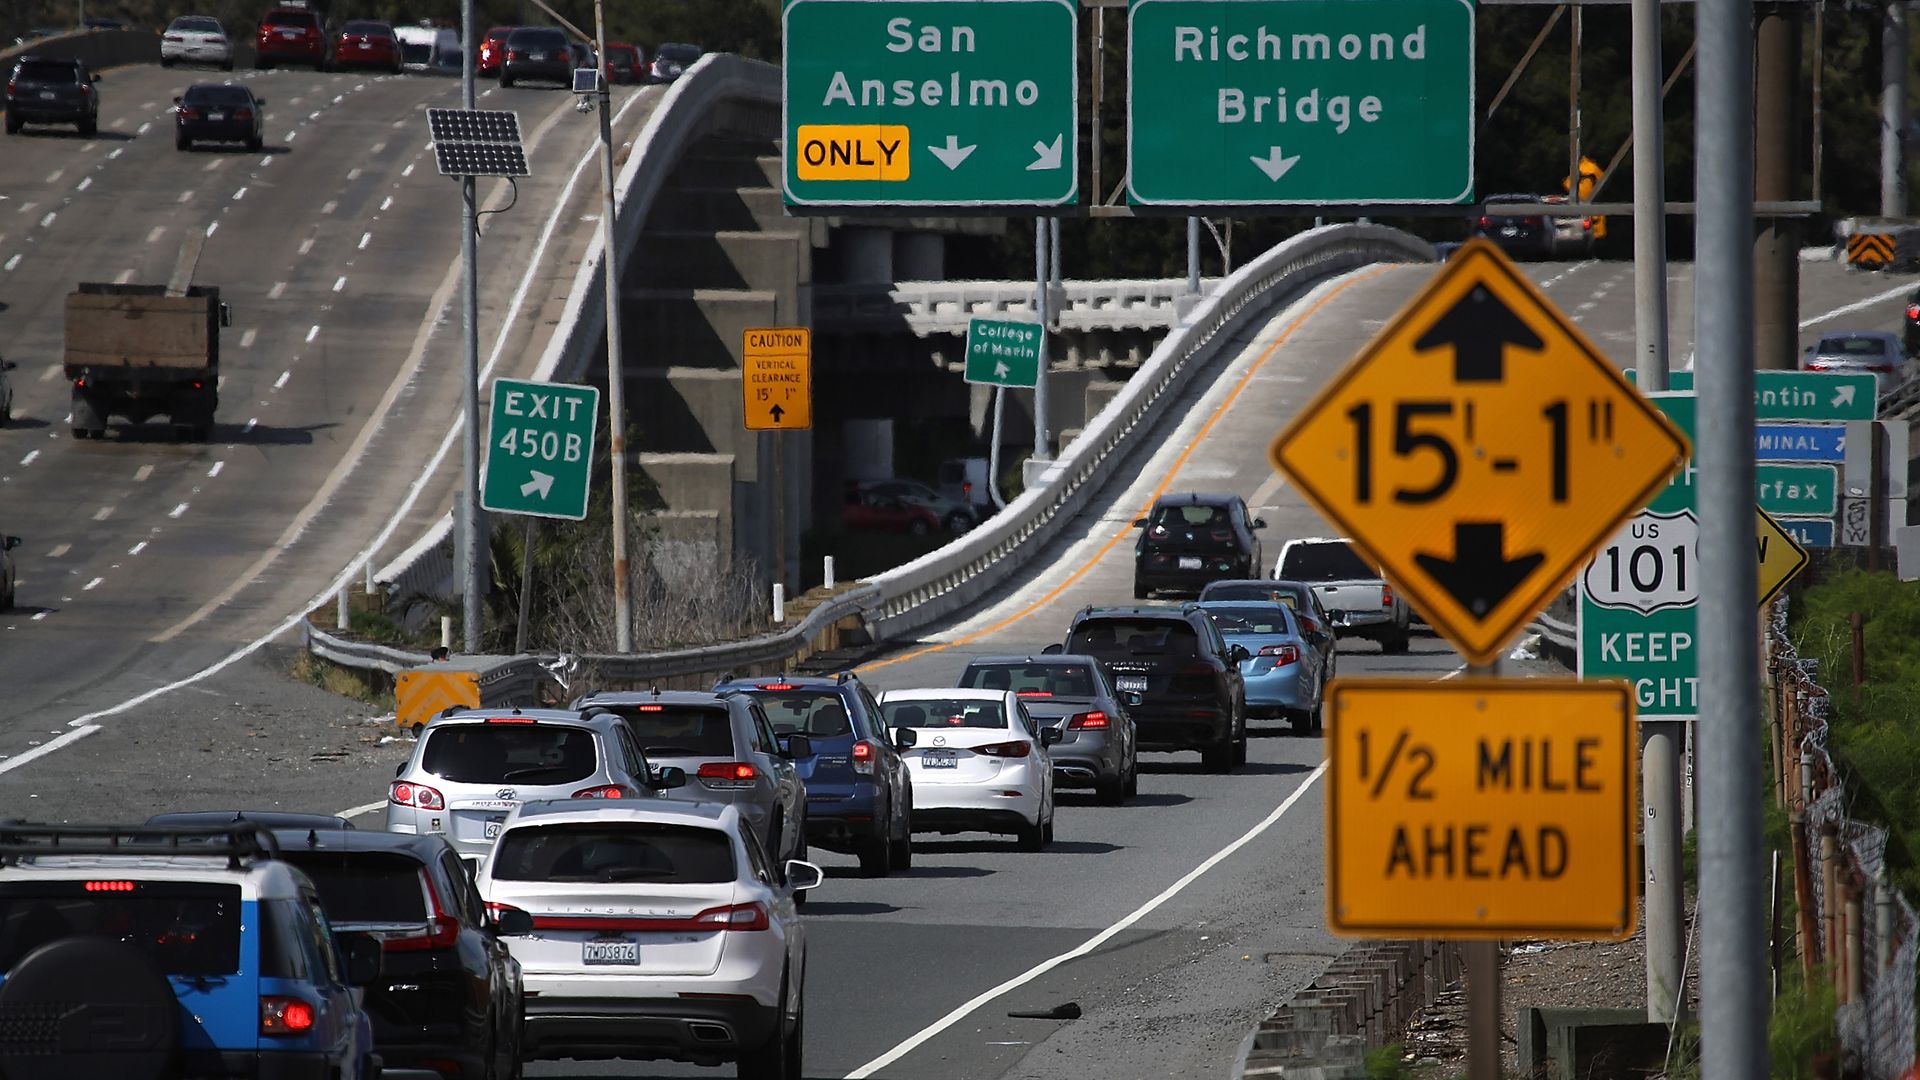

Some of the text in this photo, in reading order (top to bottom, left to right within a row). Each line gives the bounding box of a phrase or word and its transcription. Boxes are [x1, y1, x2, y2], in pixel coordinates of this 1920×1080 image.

[886, 18, 975, 53] San
[1175, 25, 1427, 61] Richmond
[823, 72, 1039, 107] Anselmo
[1217, 88, 1383, 134] Bridge
[804, 140, 901, 166] ONLY
[750, 334, 802, 348] CAUTION
[978, 324, 1033, 342] College
[973, 342, 1034, 358] of Marin
[751, 374, 801, 383] CLEARANCE
[756, 361, 796, 370] VERTICAL
[504, 391, 583, 421] EXIT
[1754, 387, 1816, 406] ntin
[499, 427, 582, 462] 450B
[1755, 435, 1820, 450] MINAL
[1760, 481, 1818, 500] rfax
[1632, 524, 1660, 539] US
[1607, 545, 1686, 593] 101
[1602, 632, 1692, 662] KEEP
[1622, 677, 1698, 708] GHT
[1357, 728, 1603, 801] 1/2 MILE
[1385, 824, 1569, 880] AHEAD
